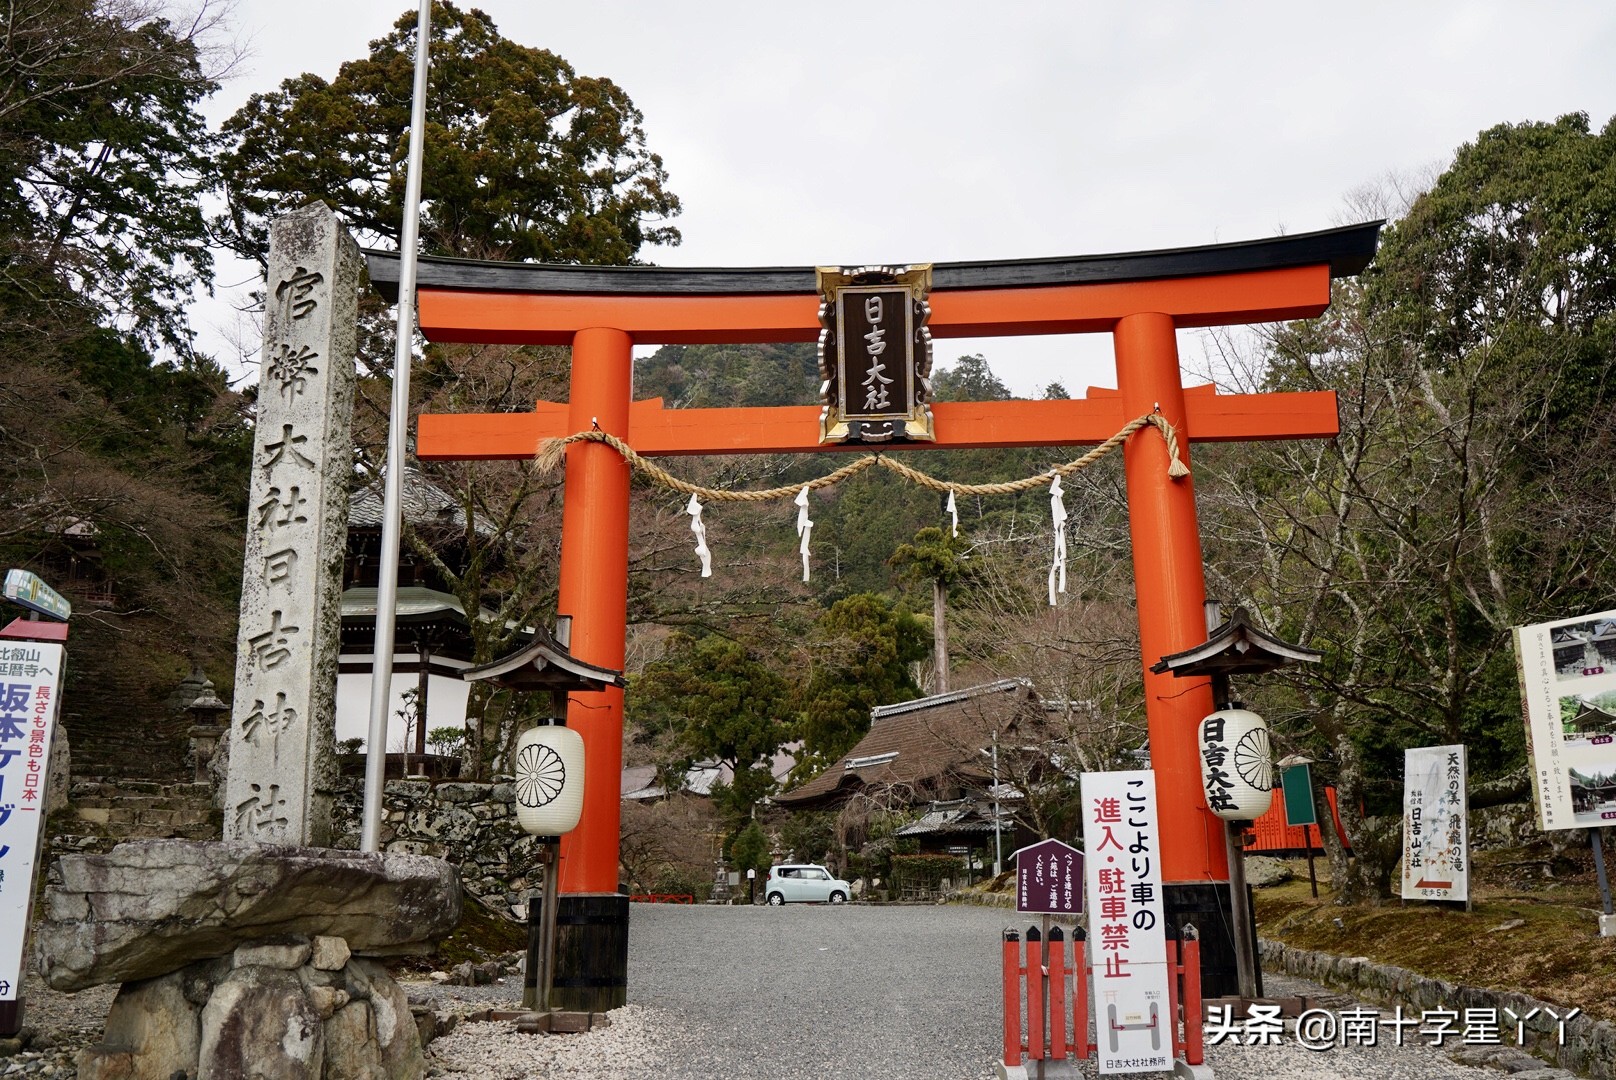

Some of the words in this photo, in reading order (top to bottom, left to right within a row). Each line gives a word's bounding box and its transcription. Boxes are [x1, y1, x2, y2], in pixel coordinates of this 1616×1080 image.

[861, 296, 895, 410] 日吉大社
[20, 686, 51, 811] 長さも景色も日本一
[1202, 717, 1240, 812] 日吉大社
[1447, 752, 1461, 806] 天然の美
[1035, 854, 1044, 886] ください。
[1126, 779, 1156, 931] ここより車の
[1411, 807, 1423, 868] 日吉山荘
[1064, 852, 1073, 910] ペットを連れての
[1094, 797, 1131, 979] 進入・駐車禁止
[1106, 1056, 1167, 1070] 日吉大社社務所
